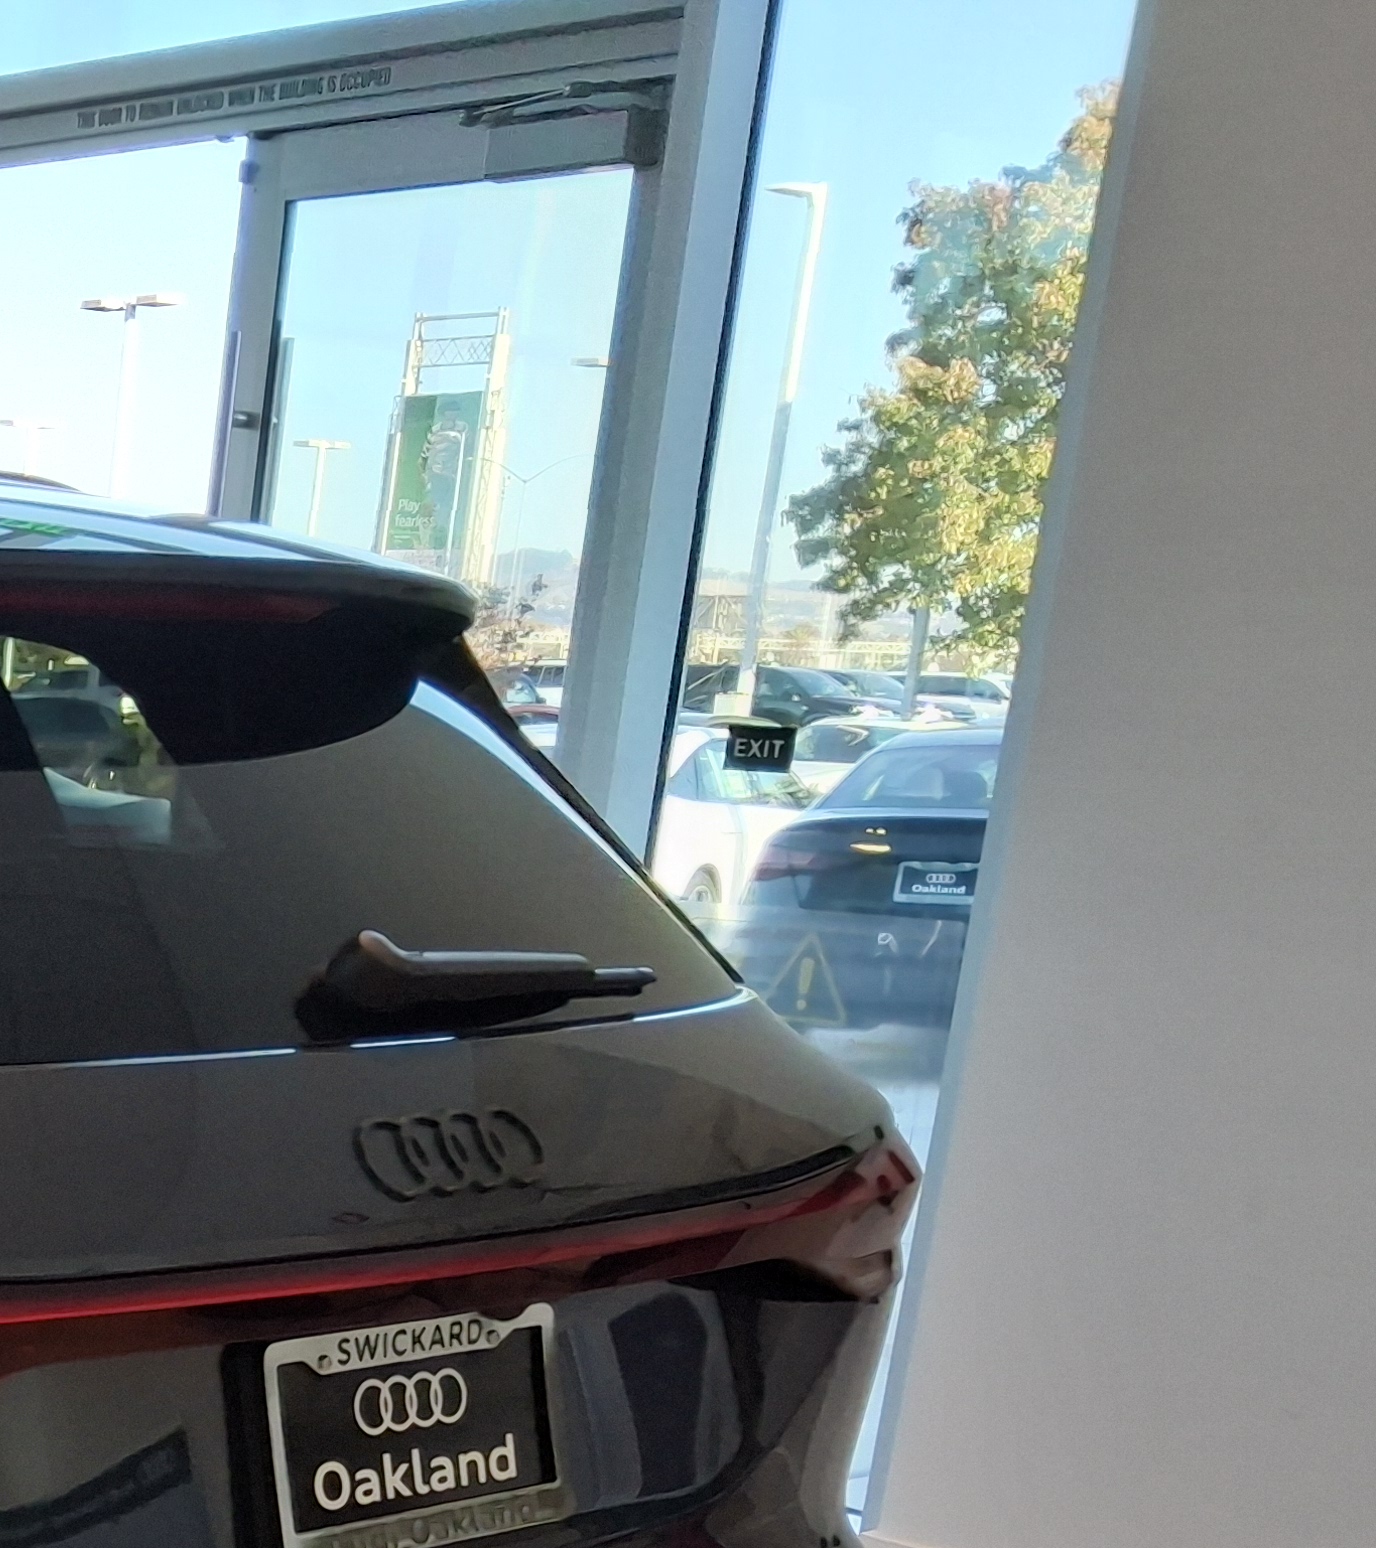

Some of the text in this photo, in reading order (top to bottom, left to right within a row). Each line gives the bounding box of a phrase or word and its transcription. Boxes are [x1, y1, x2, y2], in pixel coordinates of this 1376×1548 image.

[398, 498, 421, 514] Play
[734, 738, 785, 758] EXIT
[911, 884, 967, 894] Oakland
[337, 1318, 483, 1366] SWICKARD
[313, 1432, 518, 1512] Oakland
